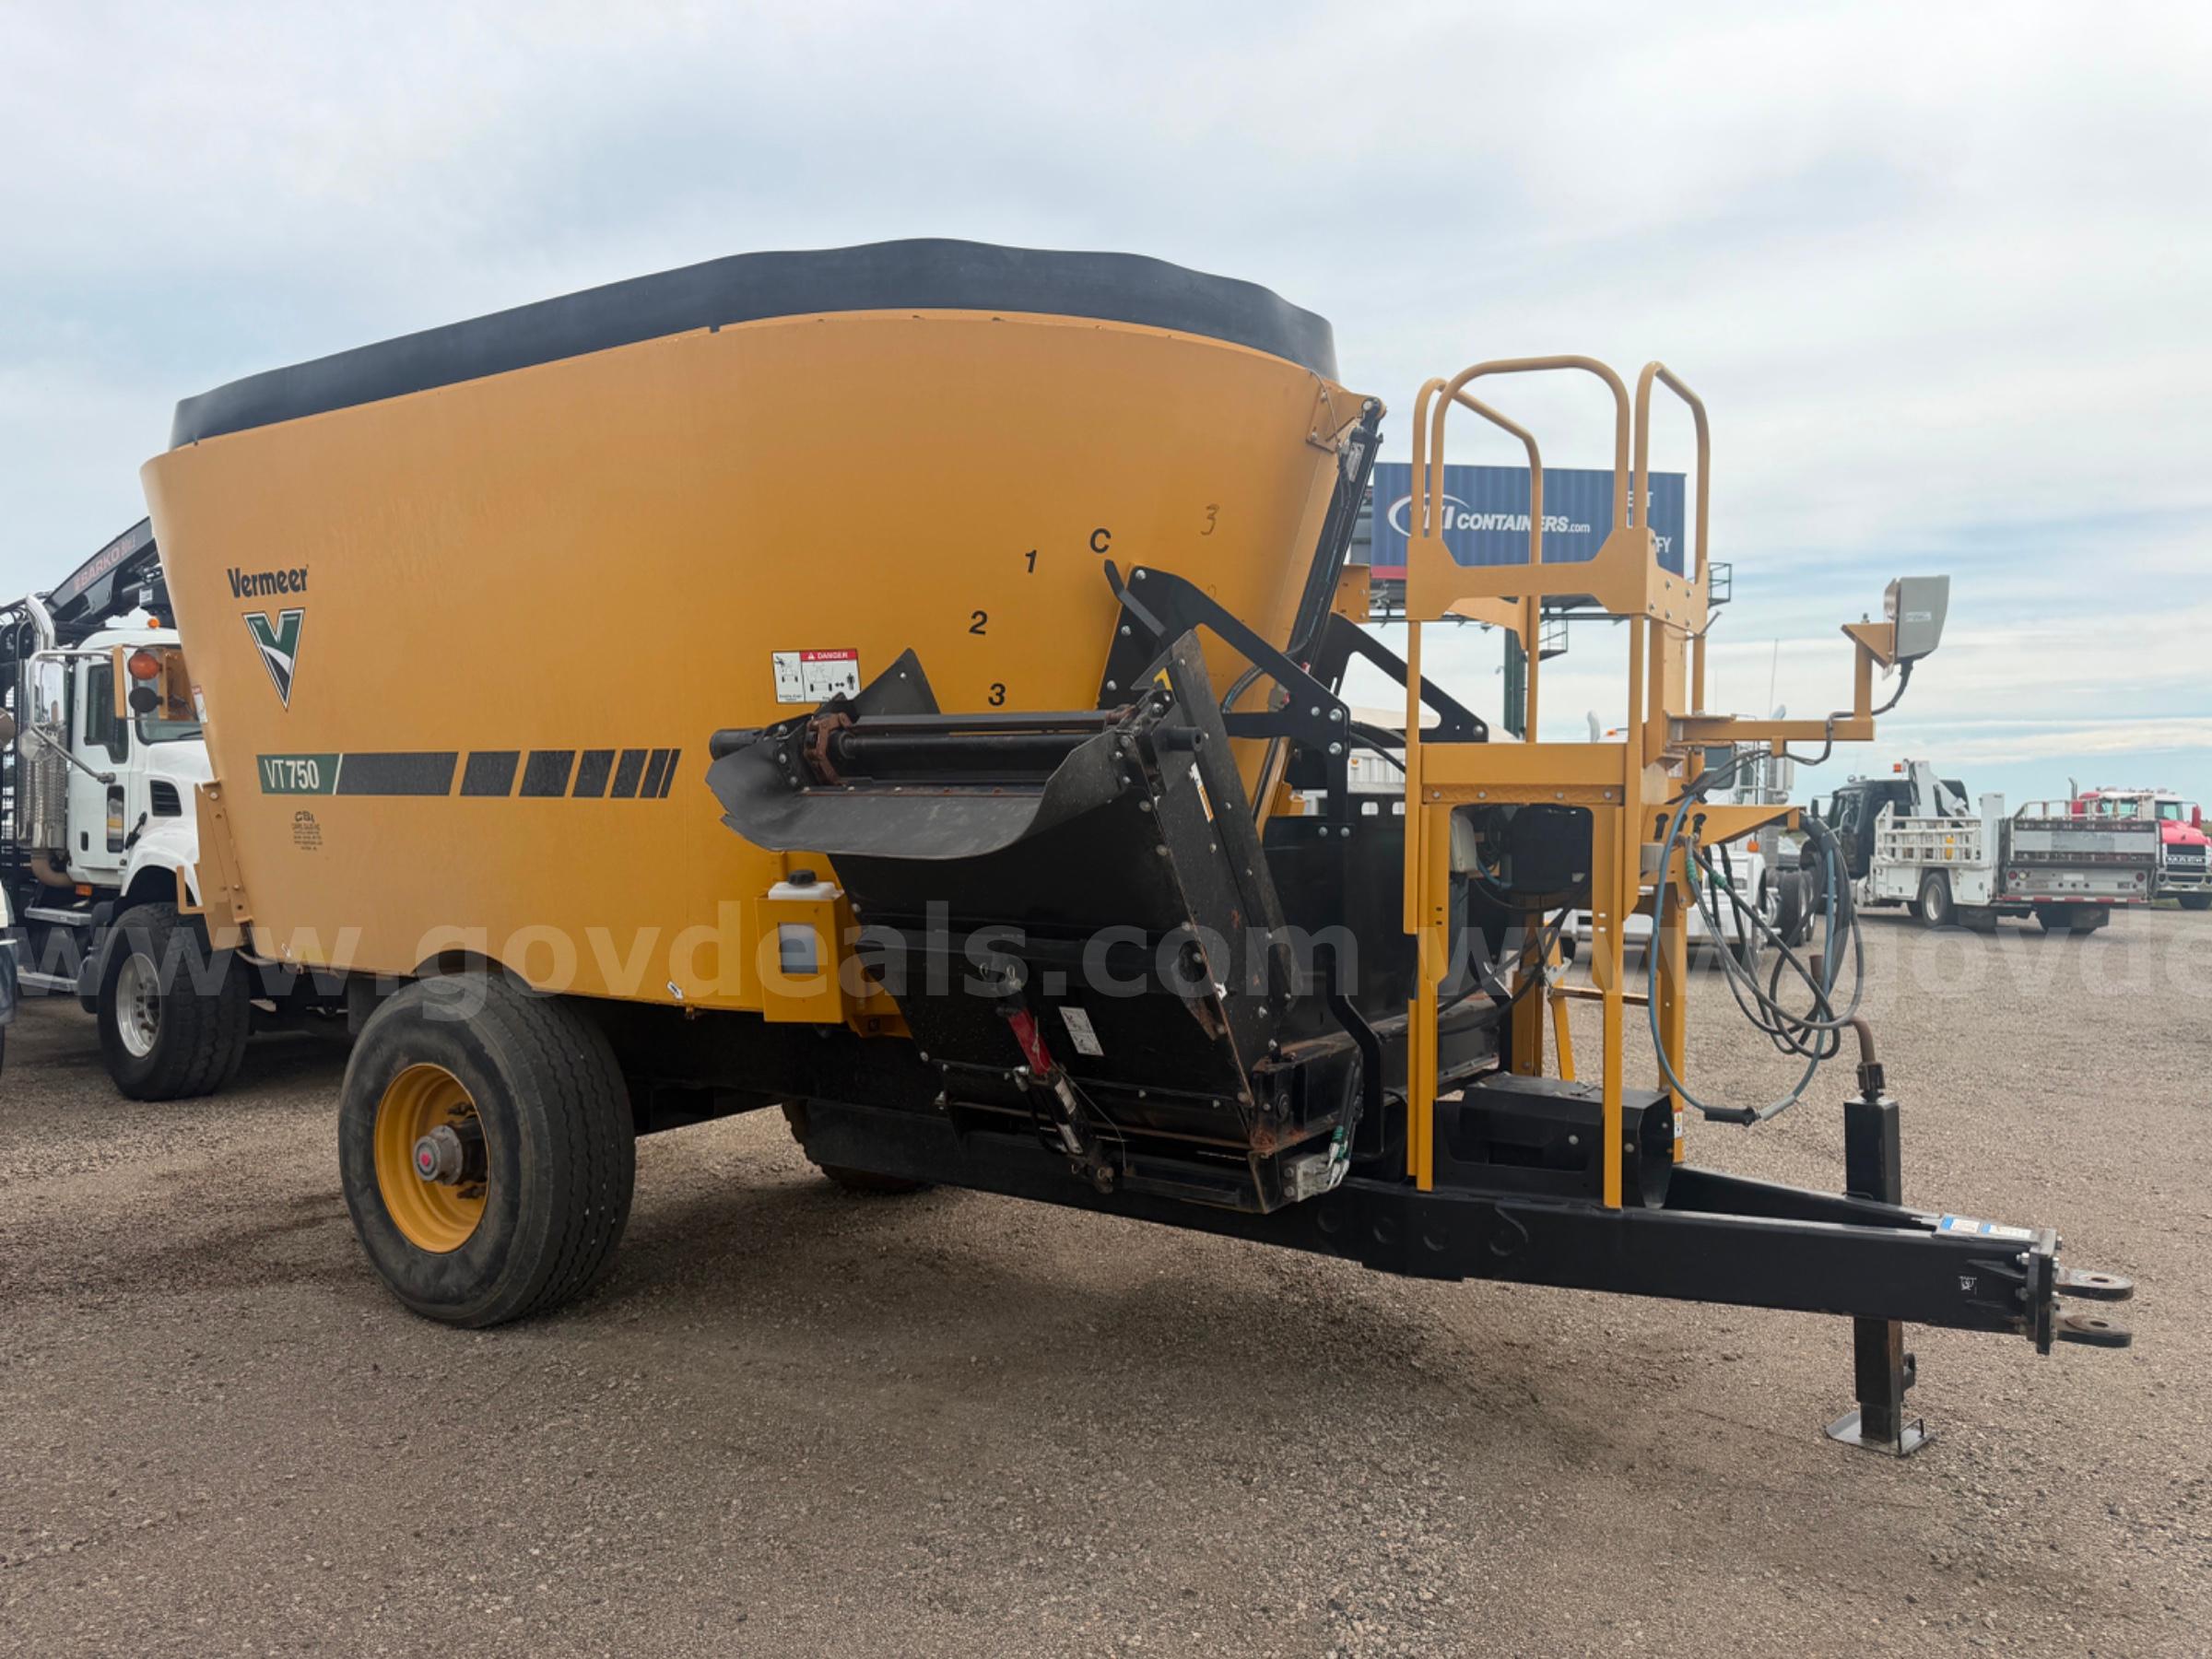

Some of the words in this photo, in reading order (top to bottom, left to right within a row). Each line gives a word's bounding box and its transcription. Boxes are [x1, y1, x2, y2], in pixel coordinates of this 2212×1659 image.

[1200, 503, 1219, 535] 3
[1089, 528, 1112, 554] C
[1025, 549, 1037, 573] 1
[228, 567, 308, 599] Vermeer
[969, 610, 988, 635] 2
[817, 651, 848, 660] DANGER
[988, 683, 1006, 706] 3
